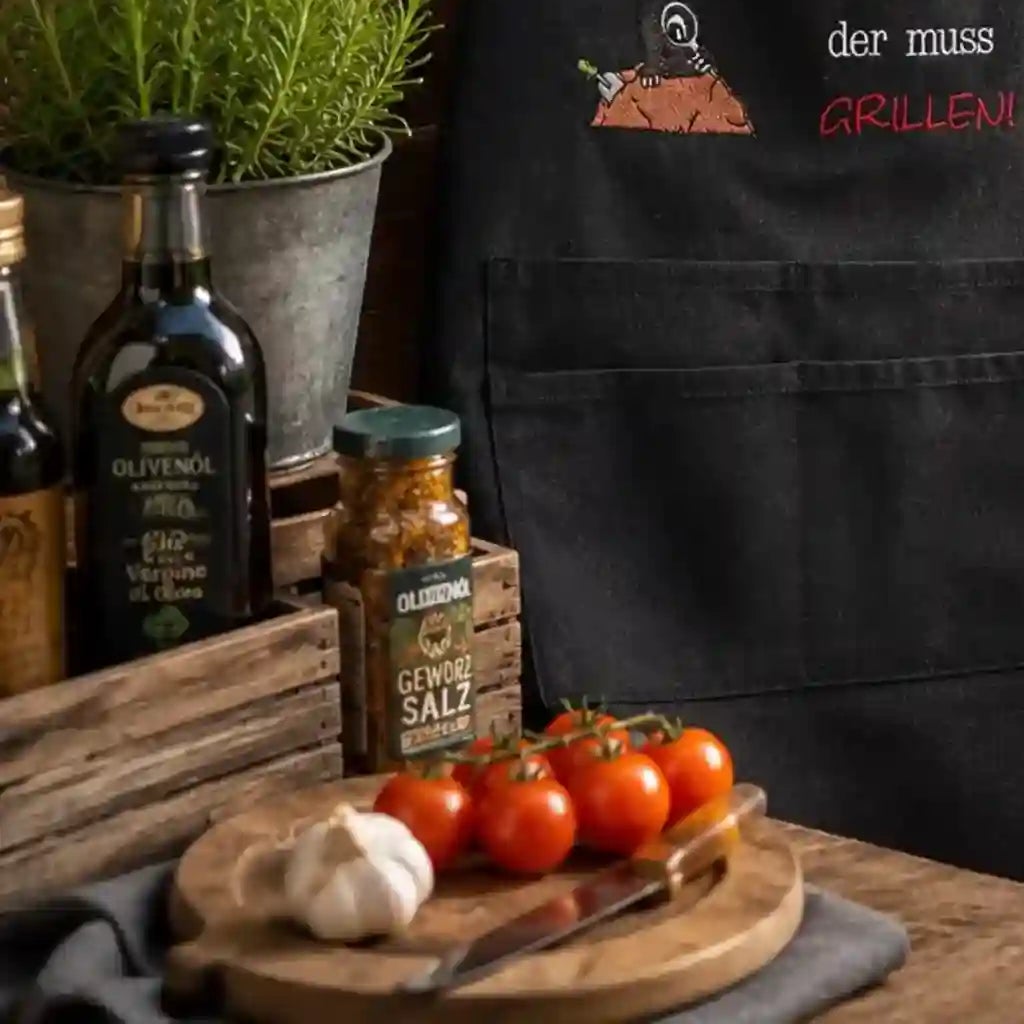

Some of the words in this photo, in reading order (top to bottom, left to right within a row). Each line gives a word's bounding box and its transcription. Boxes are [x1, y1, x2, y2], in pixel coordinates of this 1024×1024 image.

[828, 21, 888, 58] der
[905, 25, 995, 55] muss
[819, 92, 1016, 138] GRILLEN!
[401, 681, 471, 726] SALZ
